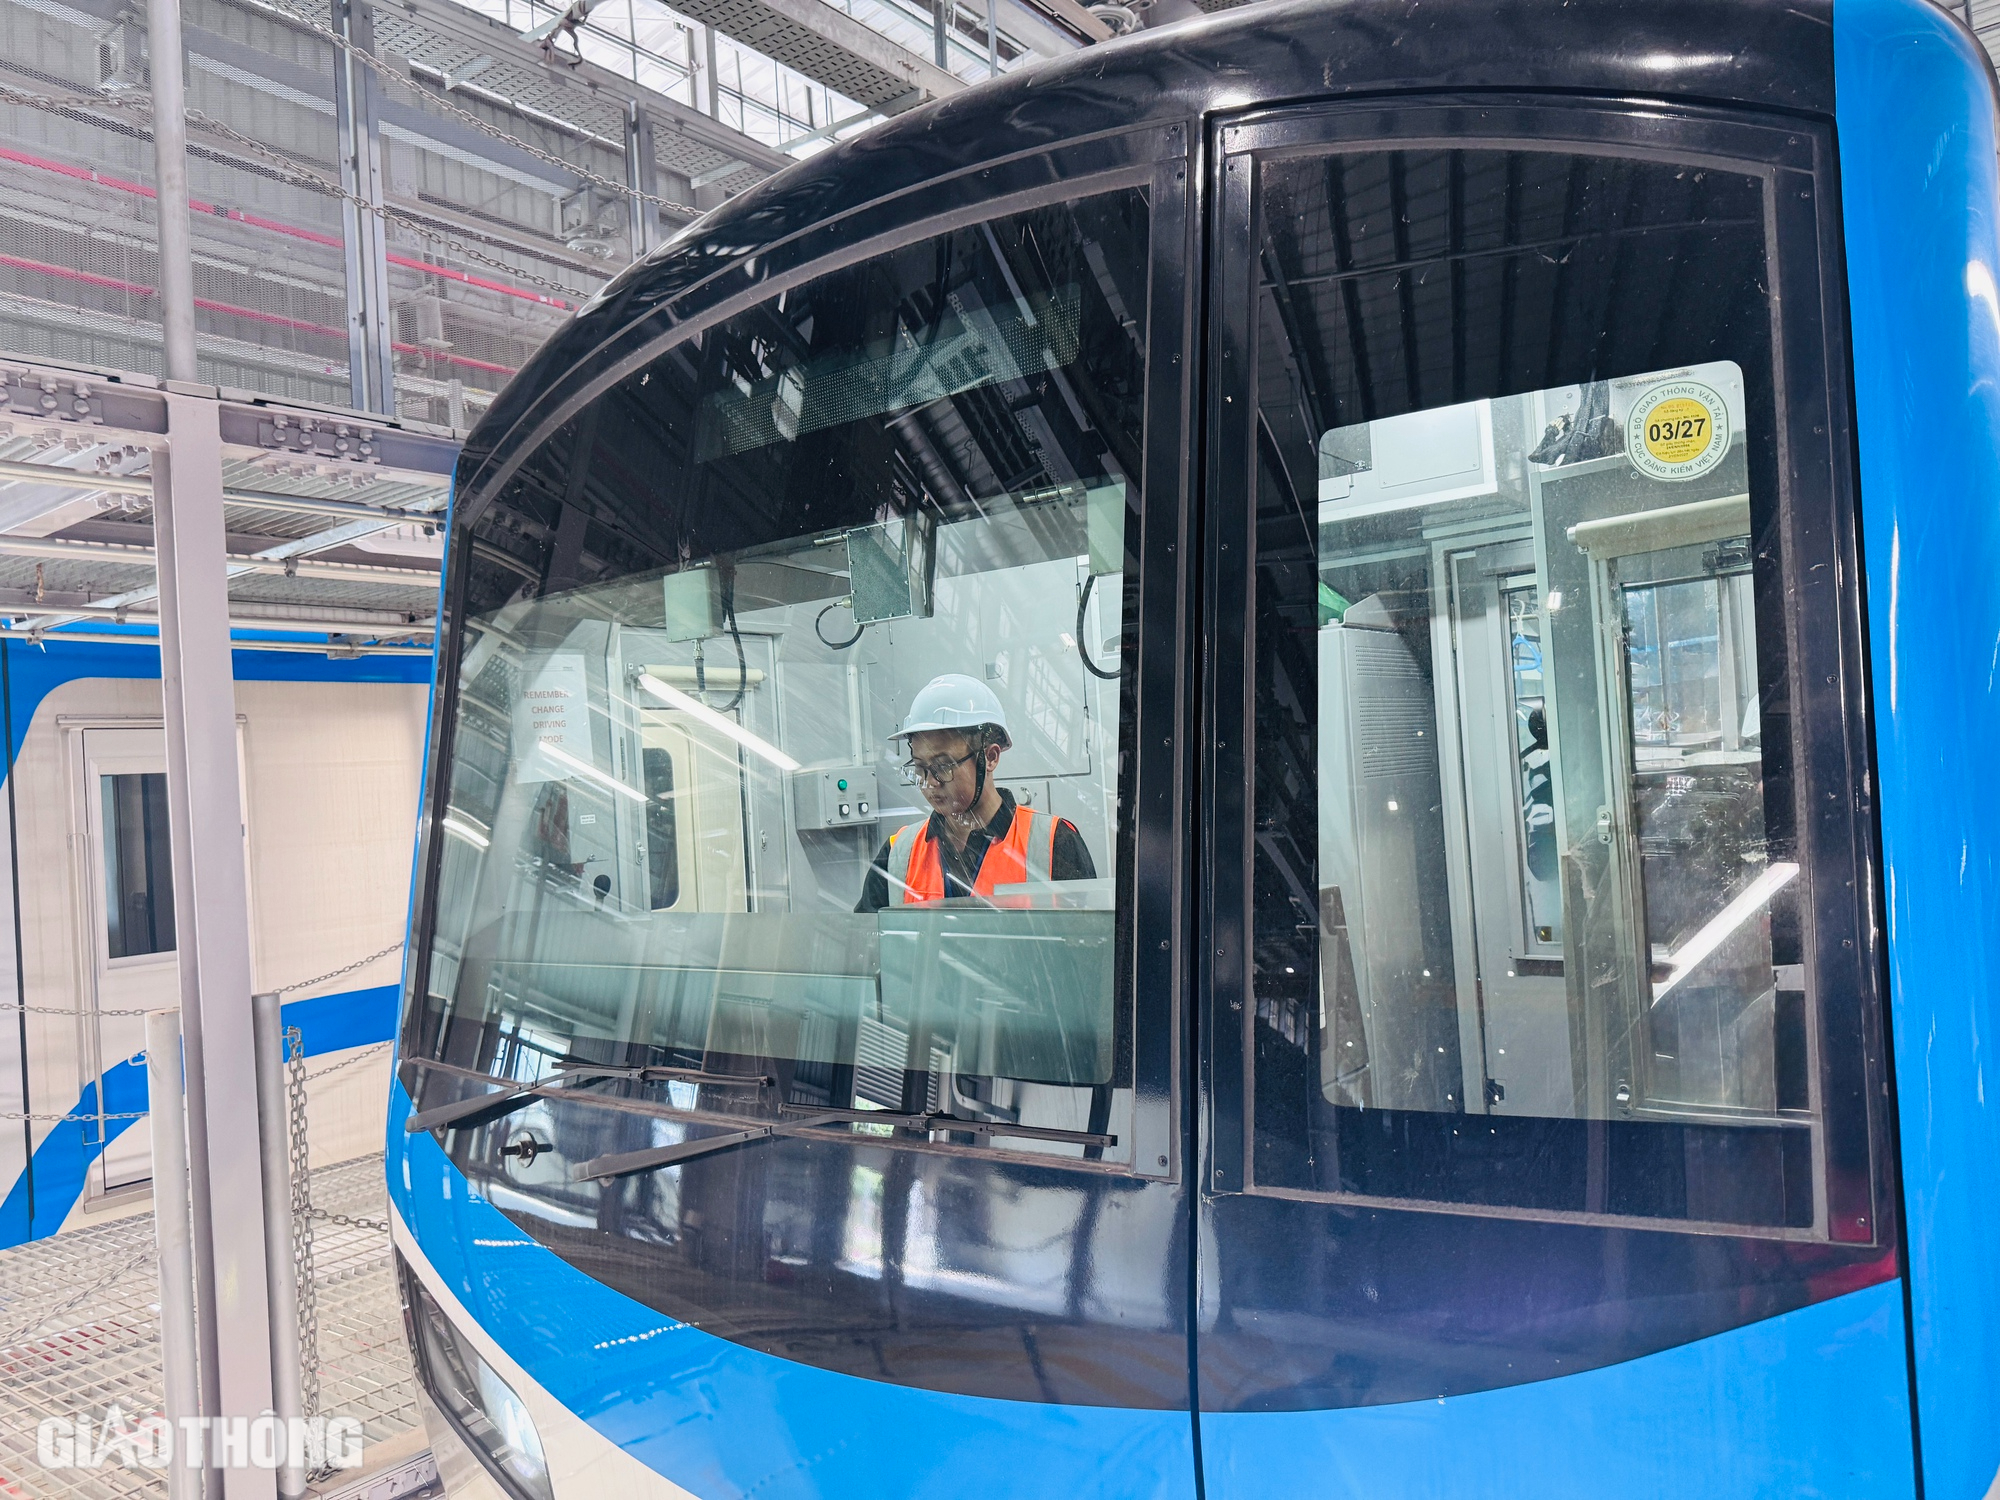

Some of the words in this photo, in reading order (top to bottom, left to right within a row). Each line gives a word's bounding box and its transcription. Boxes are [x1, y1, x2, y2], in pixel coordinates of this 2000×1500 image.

[1639, 395, 1658, 414] GIAO
[1660, 386, 1695, 397] THÔNG
[1698, 390, 1716, 405] VẬN
[1713, 406, 1724, 420] TẢI
[1649, 418, 1706, 442] 03/27
[1670, 463, 1693, 474] KIỂM
[1695, 453, 1713, 468] VIỆT
[1712, 434, 1723, 451] NAM
[531, 705, 565, 714] CHANGE
[533, 720, 566, 729] DRIVING
